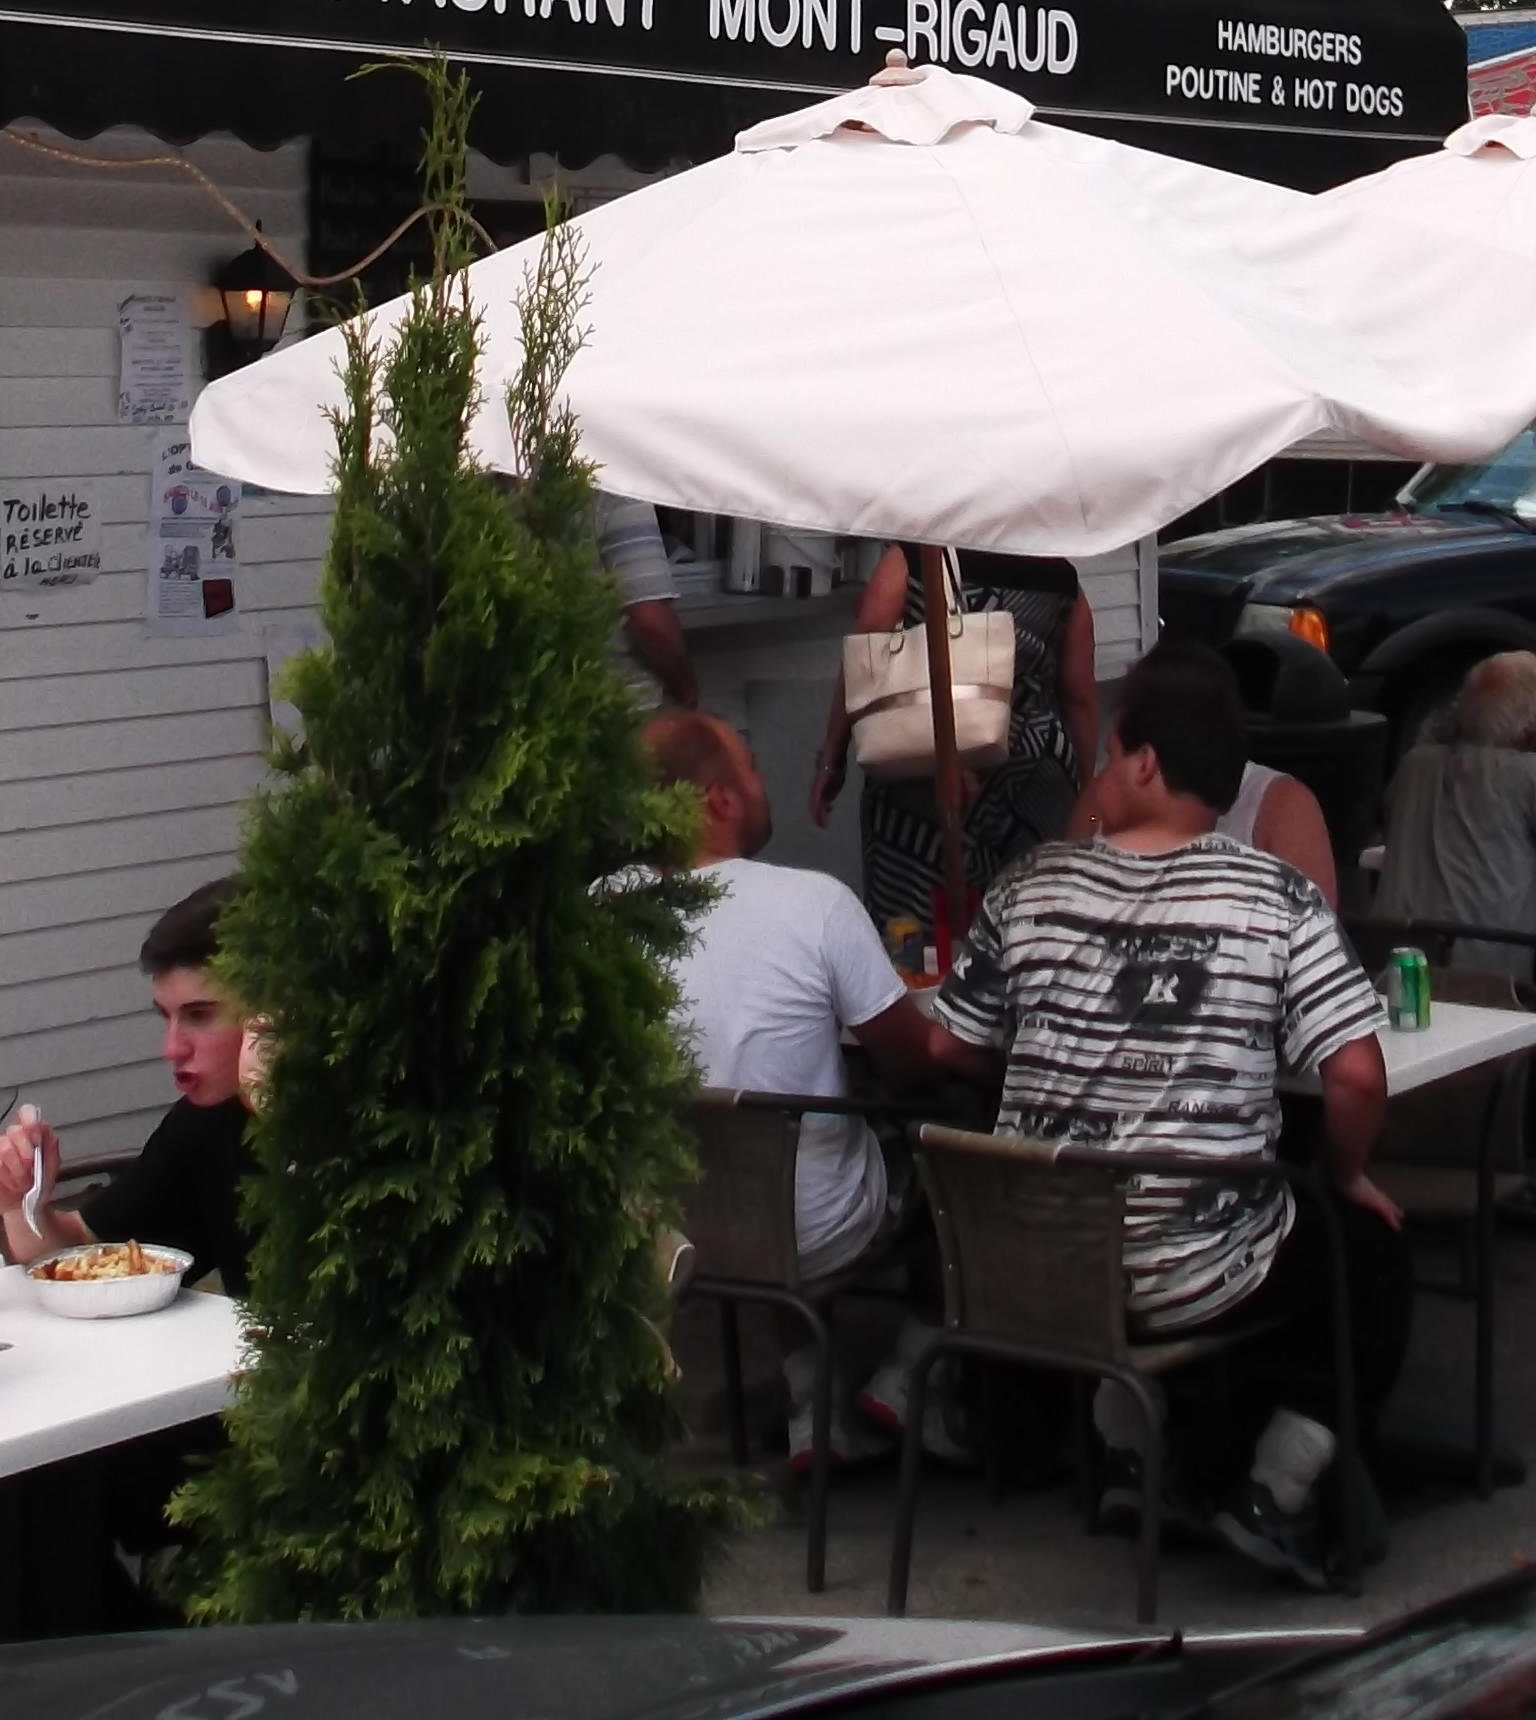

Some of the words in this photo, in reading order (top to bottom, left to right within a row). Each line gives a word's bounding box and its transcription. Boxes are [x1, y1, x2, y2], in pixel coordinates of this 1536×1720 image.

[1218, 19, 1362, 66] HAMBURGERS
[1166, 64, 1262, 104] POUTINE
[1271, 75, 1285, 106] &
[1294, 77, 1338, 110] HOT
[1346, 82, 1404, 117] DOGS
[2, 492, 91, 524] Toilette
[24, 553, 47, 575] la
